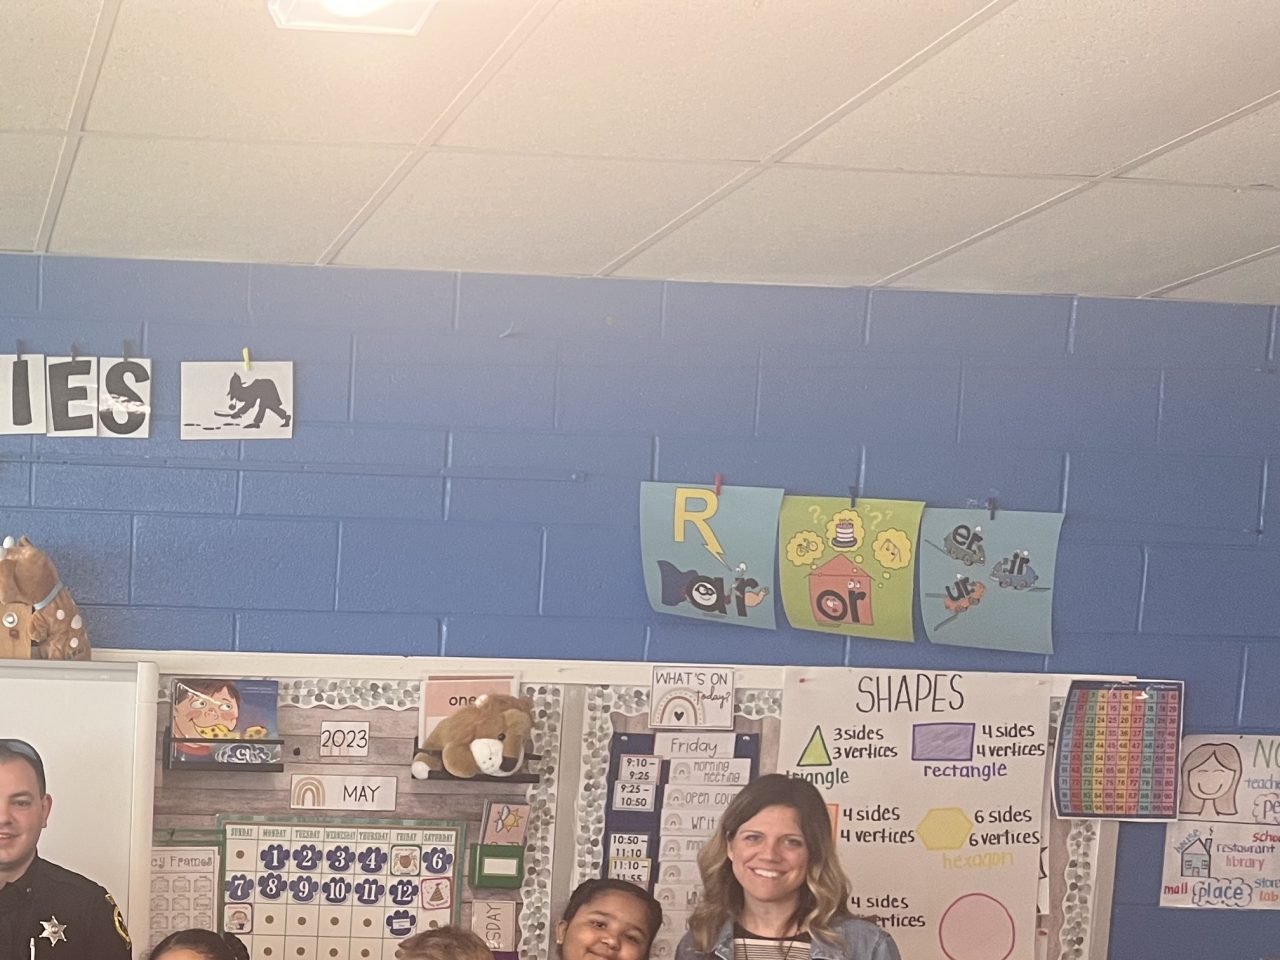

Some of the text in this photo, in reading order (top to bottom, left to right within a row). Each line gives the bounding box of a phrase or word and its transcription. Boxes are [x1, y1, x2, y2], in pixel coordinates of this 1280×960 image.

[674, 488, 727, 560] R
[817, 587, 867, 623] or
[655, 672, 728, 686] WHAT'S ON
[856, 673, 965, 713] SHAPES
[321, 729, 369, 749] 2023
[833, 724, 885, 741] 3 sides
[982, 723, 1036, 739] 4 sides
[671, 738, 719, 759] Friday
[832, 743, 898, 760] 3 vertices
[976, 742, 1046, 758] 4 vertices
[626, 758, 648, 767] 9:10
[629, 771, 650, 781] 9:25
[923, 761, 1009, 782] rectangle
[343, 784, 382, 803] MAY
[620, 784, 642, 794] 9:25
[621, 797, 647, 807] 10:50
[843, 805, 900, 821] 4 sides
[974, 806, 1032, 824] 6 sides
[613, 835, 639, 845] 10:50
[840, 828, 916, 844] 4 vertices
[969, 830, 1040, 847] 6 vertices
[615, 848, 642, 858] 11:10
[1215, 842, 1276, 854] restaurant
[270, 850, 443, 869] 1 2 3 4 6
[613, 861, 639, 870] 11:10
[942, 851, 1015, 871] hexagon
[1225, 856, 1265, 871] library
[234, 878, 413, 901] 7 8 9 10 11 12
[1163, 882, 1189, 895] mall
[1198, 881, 1245, 903] place
[1259, 889, 1279, 901] lab
[851, 894, 909, 909] 4 sides
[873, 914, 926, 929] ertices
